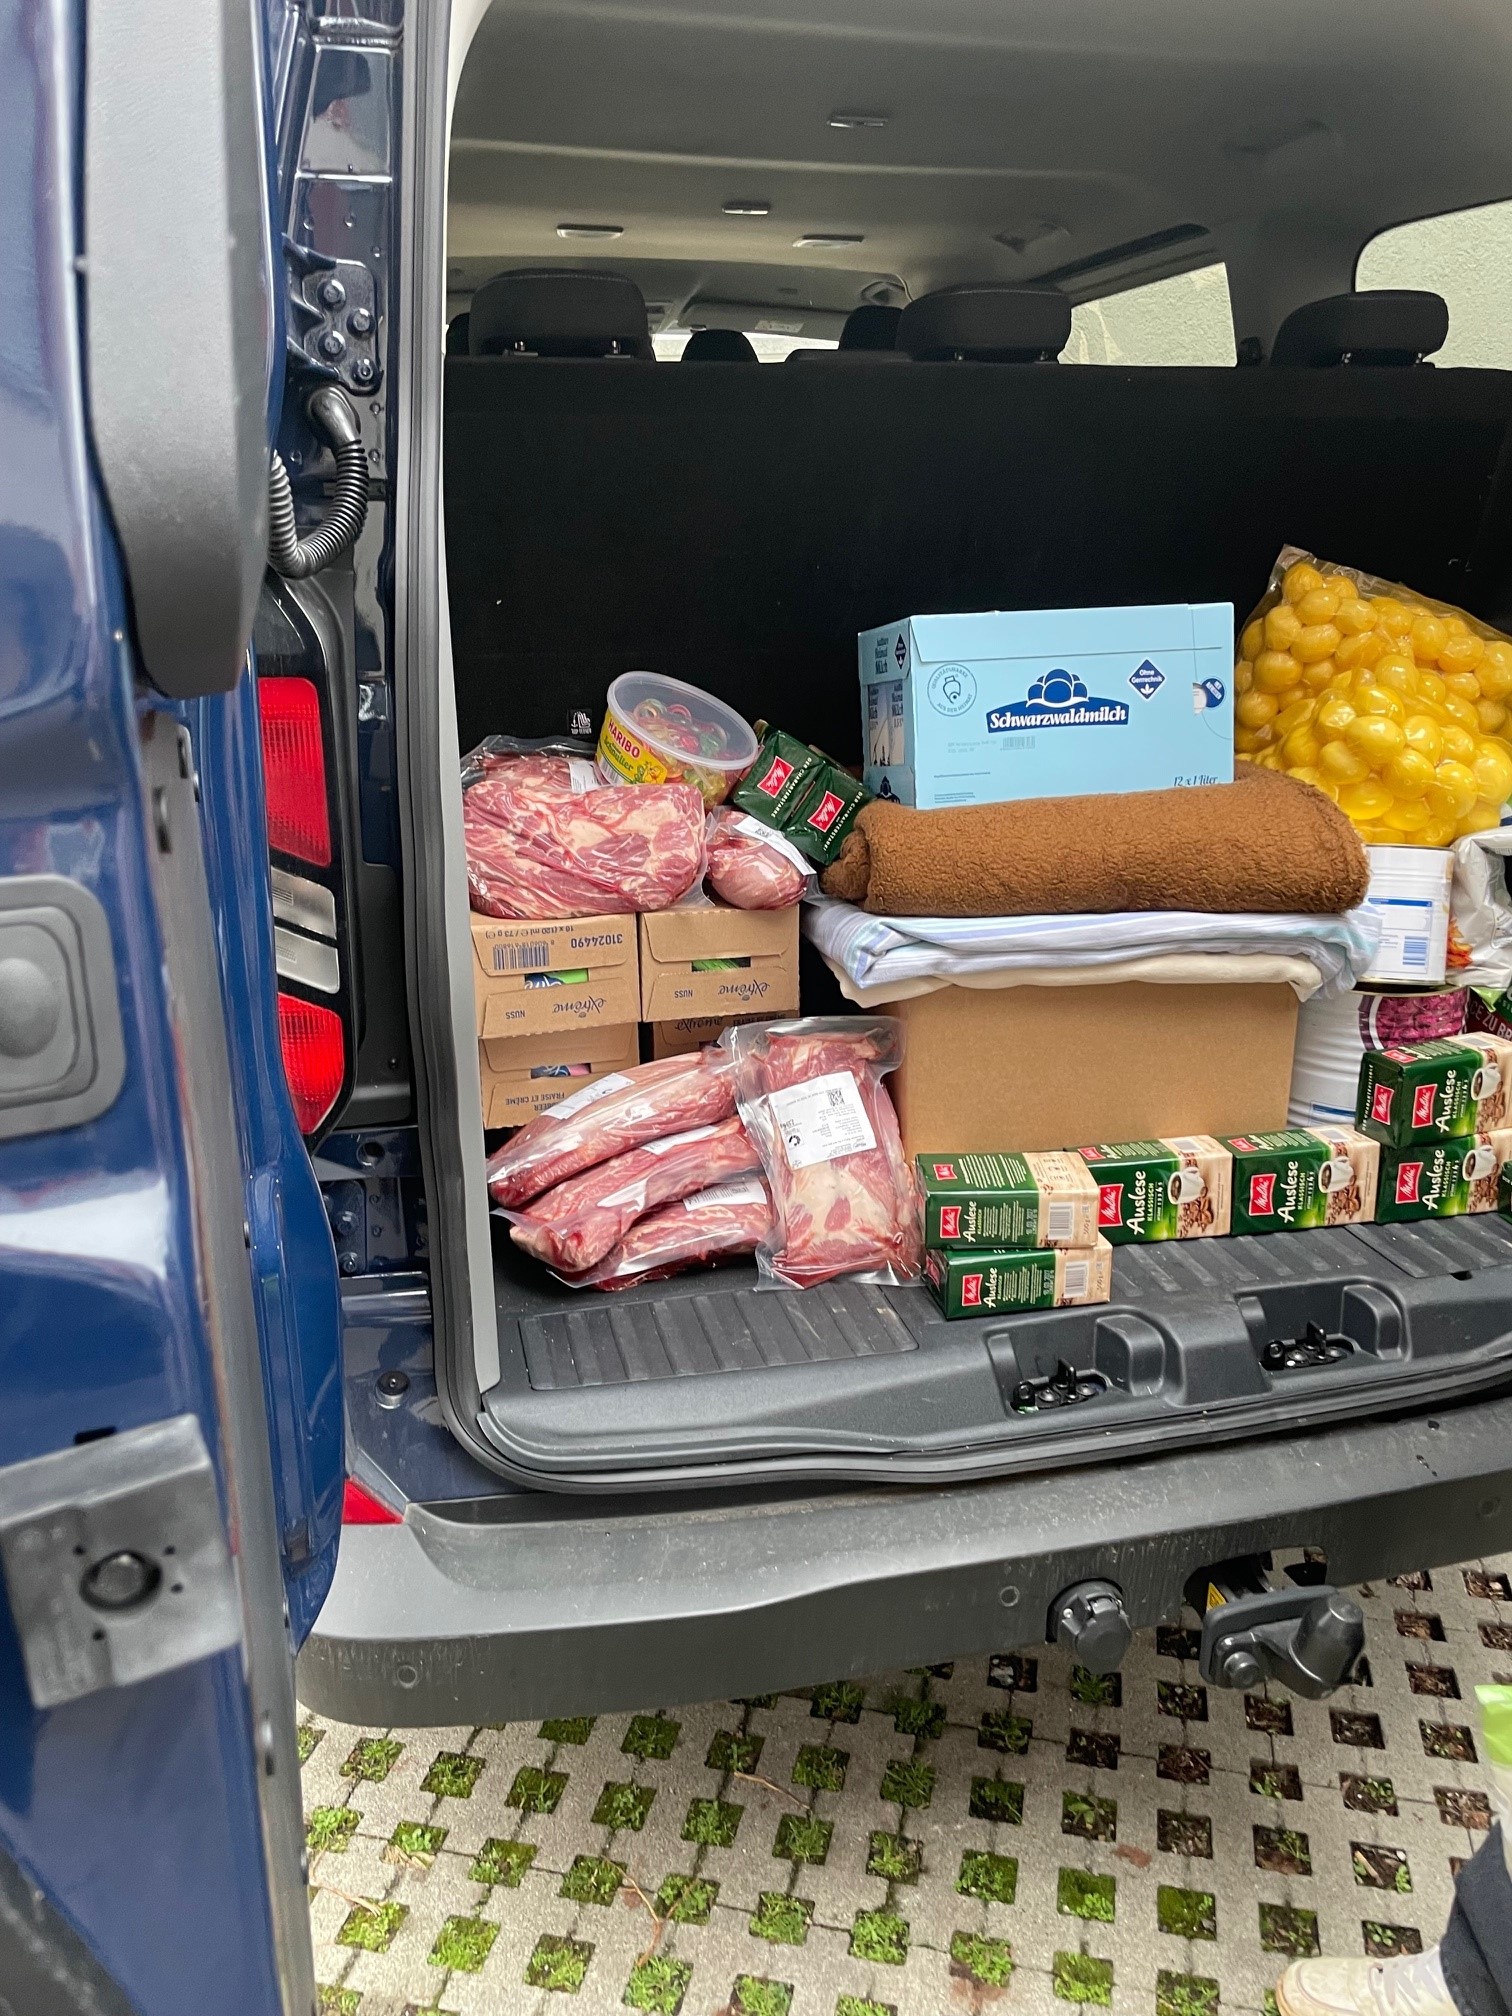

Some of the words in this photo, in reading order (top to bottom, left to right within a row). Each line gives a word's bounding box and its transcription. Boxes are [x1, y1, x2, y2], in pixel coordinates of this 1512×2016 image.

[989, 705, 1127, 730] Schwarzwaldmilch
[608, 718, 640, 758] HARIBO
[570, 933, 623, 948] 31024490
[674, 990, 693, 998] NUSS
[506, 1010, 525, 1020] NUSS
[541, 1092, 565, 1100] FRAISE
[1416, 1089, 1430, 1121] Melitta
[1435, 1069, 1457, 1133] Auslese
[1452, 1081, 1461, 1119] KLASSISCH
[1254, 1178, 1269, 1211] Melitta
[1277, 1160, 1298, 1223] Auslese
[1400, 1166, 1415, 1198] Melitta
[1422, 1149, 1445, 1210] Auslese
[1441, 1161, 1451, 1197] KLASSISCH
[1101, 1188, 1116, 1222] Melitta
[1126, 1171, 1146, 1235] Auslese
[963, 1200, 977, 1243] Auslese
[983, 1267, 998, 1308] Auslese
